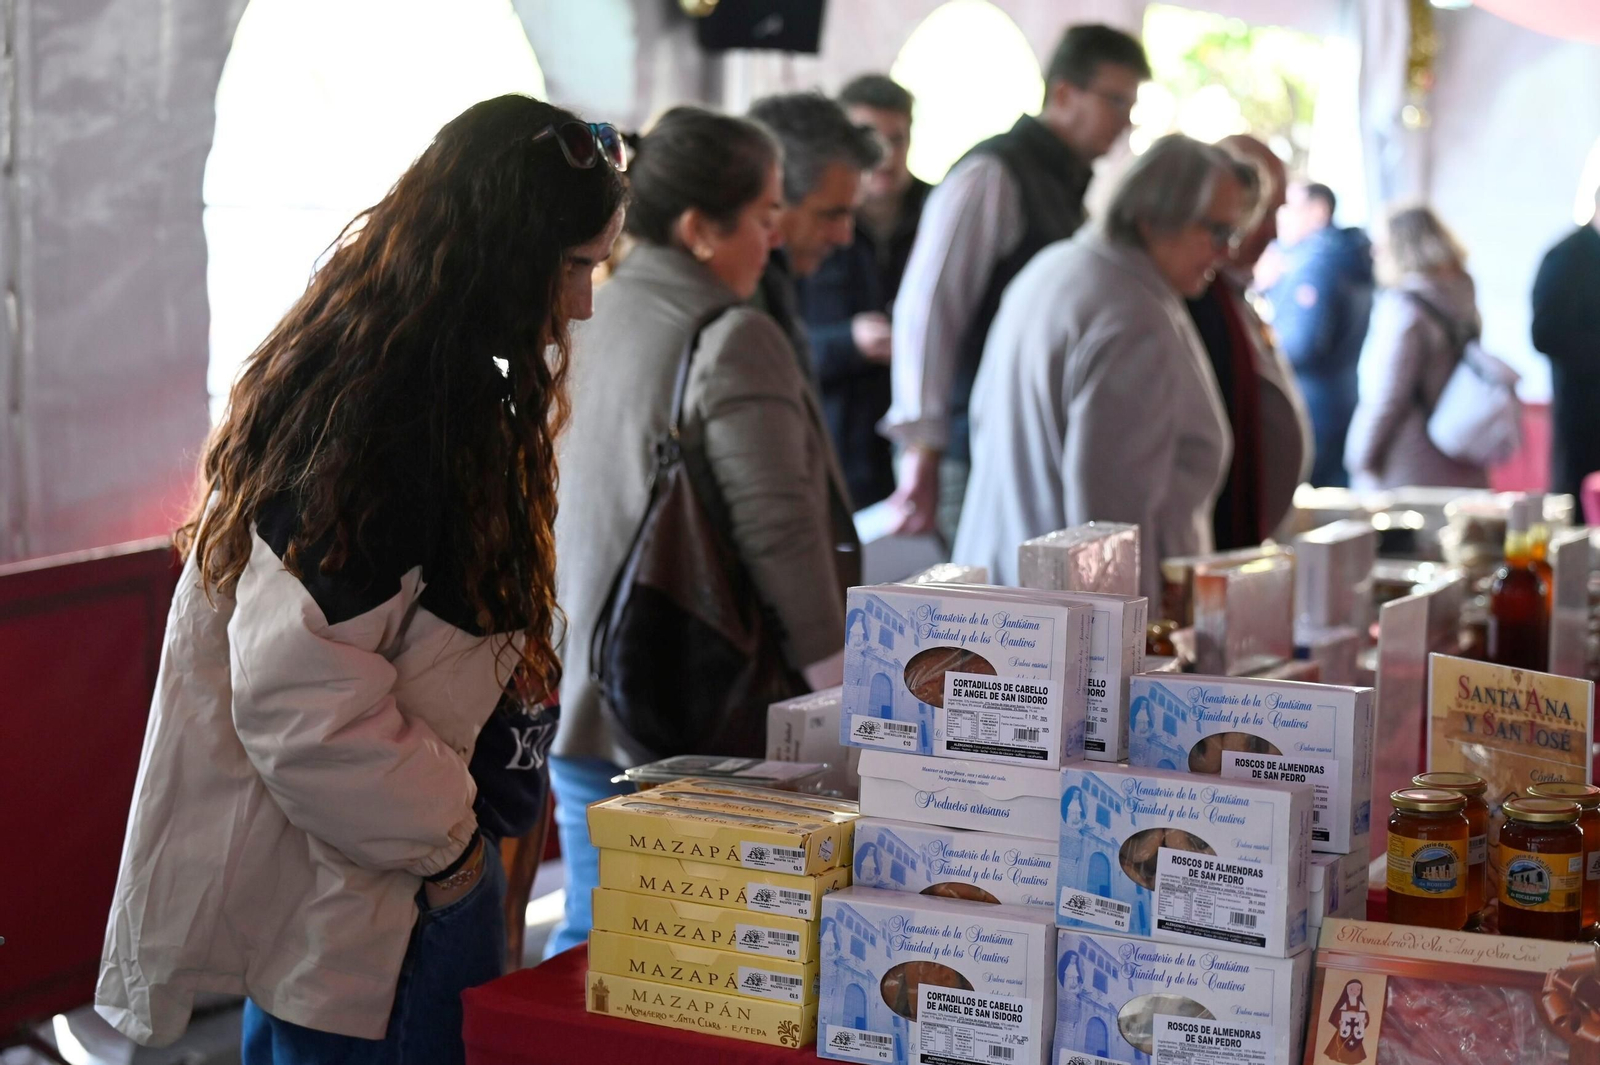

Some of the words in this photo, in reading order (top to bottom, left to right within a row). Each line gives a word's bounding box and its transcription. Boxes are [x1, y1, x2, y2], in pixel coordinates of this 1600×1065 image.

[917, 604, 966, 623] Monasterio
[969, 612, 978, 624] de
[981, 613, 989, 626] la
[992, 611, 1040, 631] Santísima
[919, 622, 959, 641] Trinidad
[961, 634, 966, 647] y
[970, 630, 978, 642] de
[980, 632, 991, 644] los
[995, 629, 1036, 650] Cautivos
[953, 678, 1002, 691] CORTADILLOS
[1004, 683, 1014, 692] DE
[1015, 684, 1048, 695] CABELLO
[953, 688, 962, 697] DE
[964, 688, 988, 699] ANGEL
[990, 691, 999, 700] DE
[1000, 692, 1016, 702] SAN
[1017, 694, 1048, 705] ISIDORO
[1187, 686, 1239, 705] Monasterio
[1240, 694, 1251, 706] de
[1252, 694, 1261, 707] la
[1264, 692, 1312, 711] Santísima
[1458, 675, 1521, 711] SANTA
[1524, 688, 1572, 720] ANA
[1189, 704, 1231, 723] Trinidad
[1232, 715, 1238, 728] y
[1240, 712, 1250, 724] de
[1252, 713, 1264, 726] los
[1267, 710, 1309, 730] Cautivos
[1465, 713, 1476, 732] Y
[1482, 711, 1522, 741] SAN
[1235, 758, 1264, 769] ROSCOS
[1266, 761, 1277, 770] DE
[1278, 761, 1325, 775] ALMENDRAS
[1252, 769, 1262, 778] DE
[1263, 770, 1279, 780] SAN
[1280, 772, 1306, 783] PEDRO
[1530, 769, 1565, 782] Córdob
[915, 790, 967, 812] Productos
[970, 801, 1011, 818] artesanos
[1120, 777, 1175, 797] Monasterio
[1176, 786, 1186, 798] de
[1188, 788, 1197, 800] la
[1200, 786, 1249, 807] Santísima
[1123, 796, 1167, 815] Trinidad
[1168, 808, 1175, 822] y
[1176, 804, 1186, 817] de
[1188, 806, 1199, 820] los
[1203, 804, 1246, 826] Cautivos
[629, 834, 741, 861] MAZAPÁ
[928, 840, 978, 859] Monasterio
[981, 849, 989, 862] de
[991, 850, 999, 862] la
[1003, 848, 1051, 869] Santísima
[931, 859, 970, 878] Trinidad
[973, 871, 978, 883] y
[981, 868, 990, 880] de
[992, 869, 1003, 881] los
[1006, 866, 1048, 887] Cautivos
[1171, 855, 1202, 868] ROSCOS
[1204, 860, 1214, 870] DE
[1215, 862, 1263, 878] ALMENDRAS
[1188, 868, 1198, 878] DE
[1200, 870, 1216, 881] SAN
[1217, 873, 1244, 886] PEDRO
[639, 875, 747, 903] MAZAPÁ
[631, 916, 736, 945] MAZAPÁ
[888, 914, 940, 936] Monasterio
[941, 925, 952, 938] de
[954, 926, 962, 939] la
[965, 924, 1014, 946] Santísima
[1337, 924, 1405, 948] Monasterio
[1486, 943, 1510, 959] San
[890, 934, 931, 954] Trinidad
[933, 947, 940, 960] y
[941, 943, 952, 956] de
[953, 945, 965, 959] los
[967, 943, 1010, 965] Cautivos
[1118, 943, 1172, 964] Monasterio
[1174, 953, 1185, 966] de
[1187, 954, 1196, 967] la
[1199, 951, 1249, 973] Santísima
[629, 958, 738, 989] MAZAPÁ
[1120, 962, 1164, 982] Trinidad
[1166, 974, 1173, 988] y
[1174, 971, 1185, 984] de
[1187, 973, 1198, 986] los
[1202, 971, 1246, 992] Cautivos
[631, 988, 752, 1020] MAZAPÁN
[927, 991, 976, 1006] CORTADILLOS
[977, 998, 987, 1008] DE
[989, 1000, 1023, 1013] CABELLO
[927, 1001, 936, 1010] DE
[937, 1002, 962, 1014] ANGEL
[964, 1006, 973, 1016] DE
[974, 1007, 990, 1018] SAN
[991, 1009, 1023, 1023] ISIDORO
[1167, 1021, 1199, 1034] ROSCOS
[1200, 1024, 1210, 1035] DE
[1212, 1026, 1261, 1040] ALMENDRAS
[1185, 1034, 1196, 1043] DE
[1197, 1035, 1214, 1045] SAN
[1215, 1038, 1241, 1048] PEDRO
